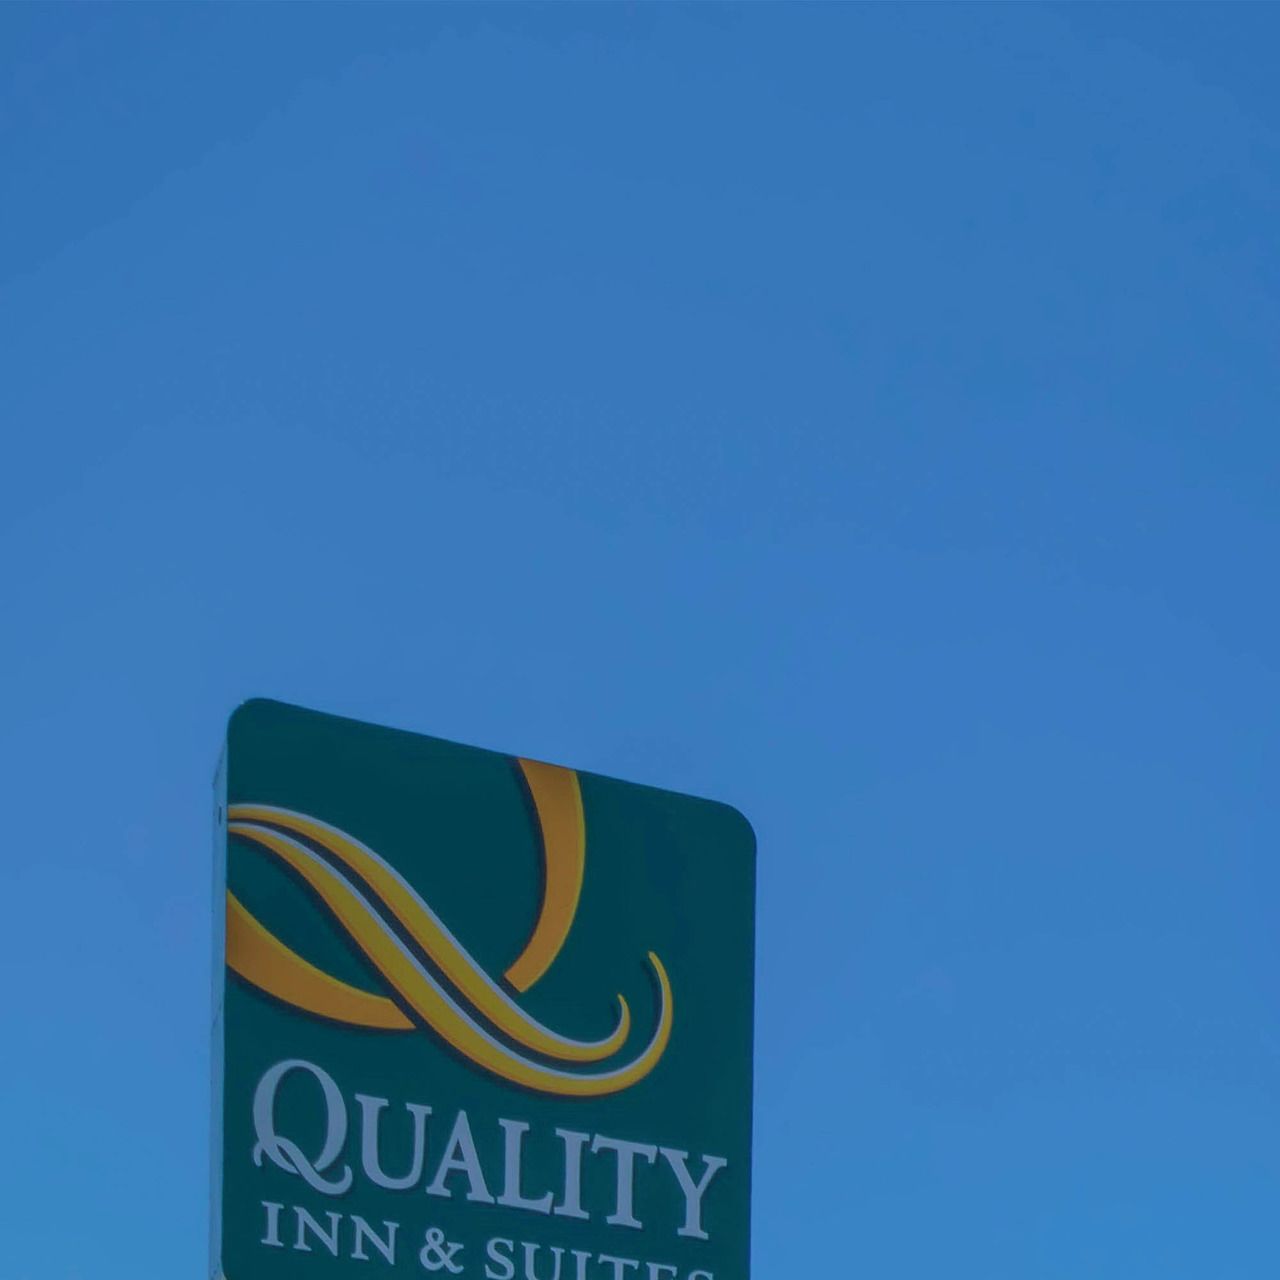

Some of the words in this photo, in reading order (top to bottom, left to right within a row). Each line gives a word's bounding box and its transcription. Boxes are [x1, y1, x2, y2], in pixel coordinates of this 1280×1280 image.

[252, 1059, 728, 1240] QUALITY
[261, 1201, 400, 1266] INN
[420, 1227, 464, 1274] &
